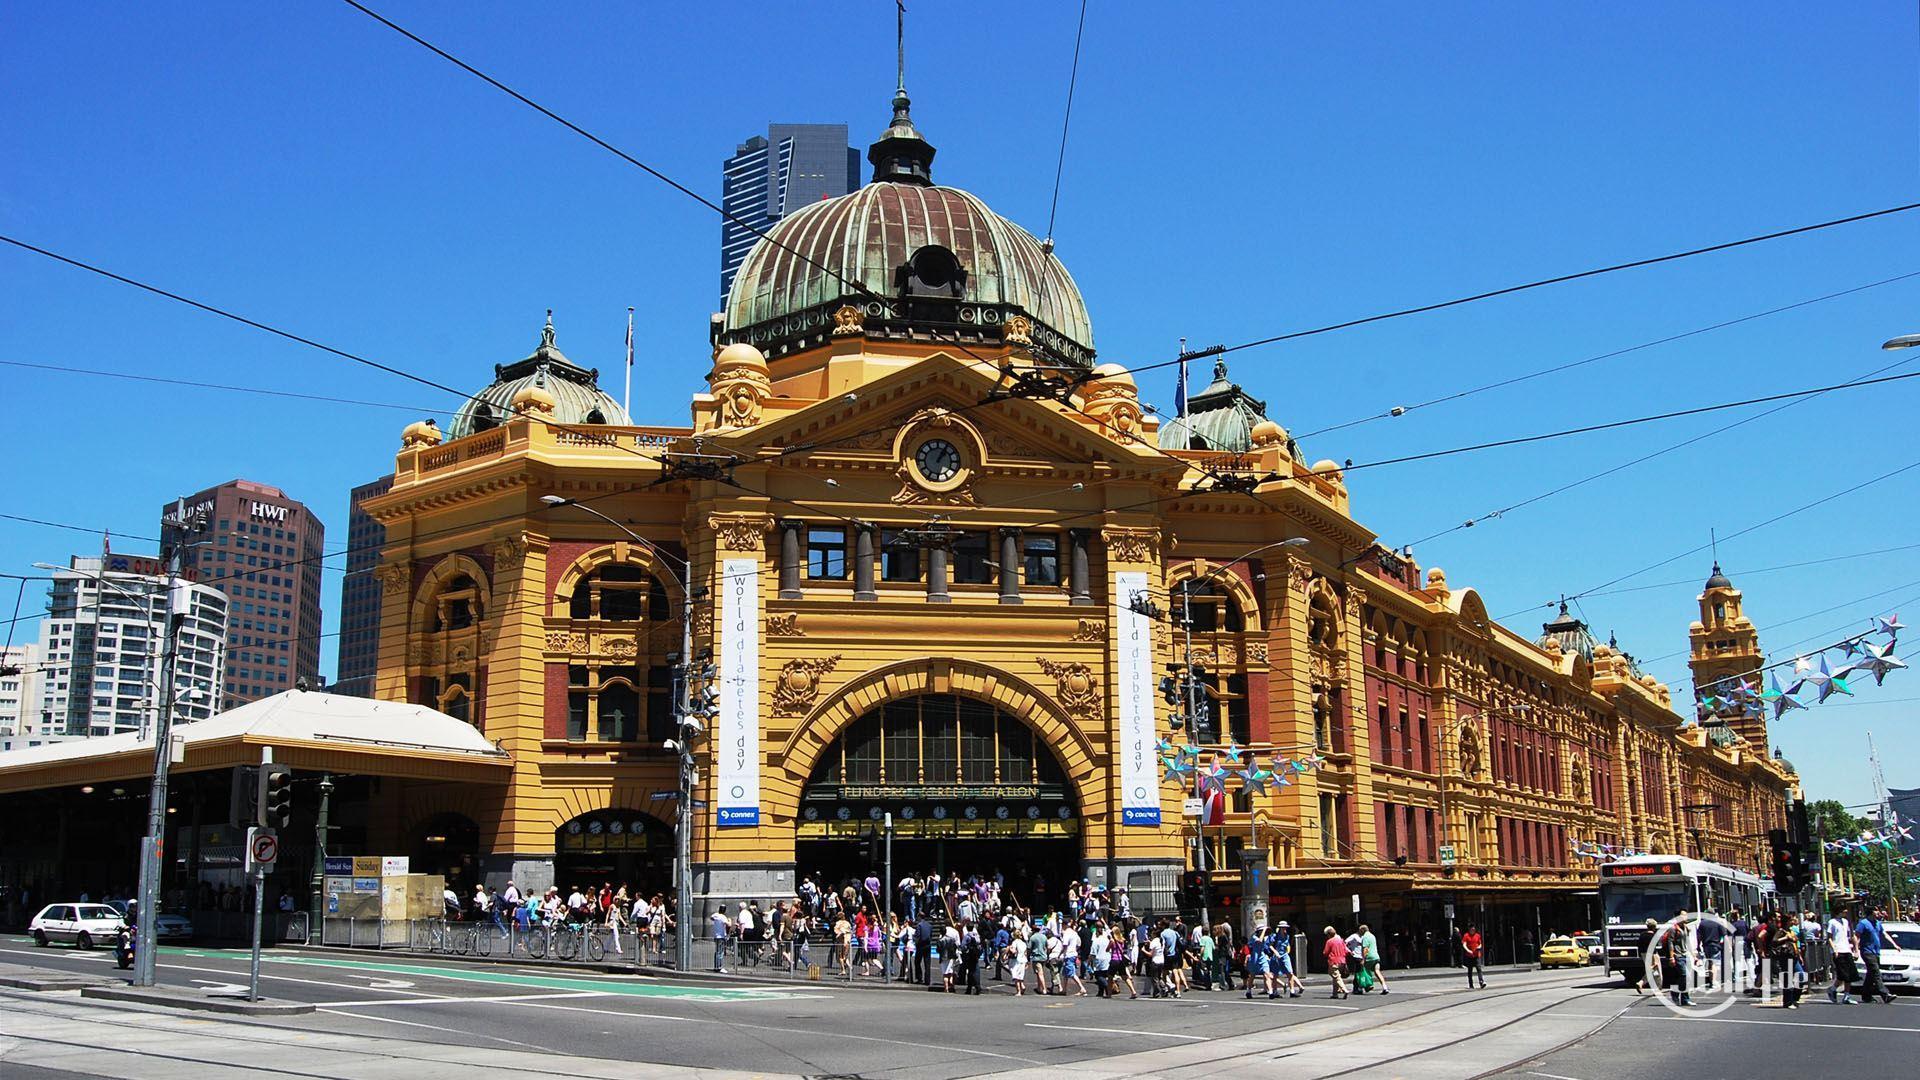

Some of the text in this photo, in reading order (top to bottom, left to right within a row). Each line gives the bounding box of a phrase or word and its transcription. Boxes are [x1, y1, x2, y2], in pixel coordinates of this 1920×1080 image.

[251, 501, 288, 521] HWT
[734, 577, 746, 770] world diabetes day
[1131, 647, 1140, 734] diabetes
[1134, 739, 1142, 772] day
[982, 786, 1037, 797] STATION
[730, 811, 756, 819] connex
[356, 861, 377, 872] Sunday
[1662, 865, 1670, 873] 48
